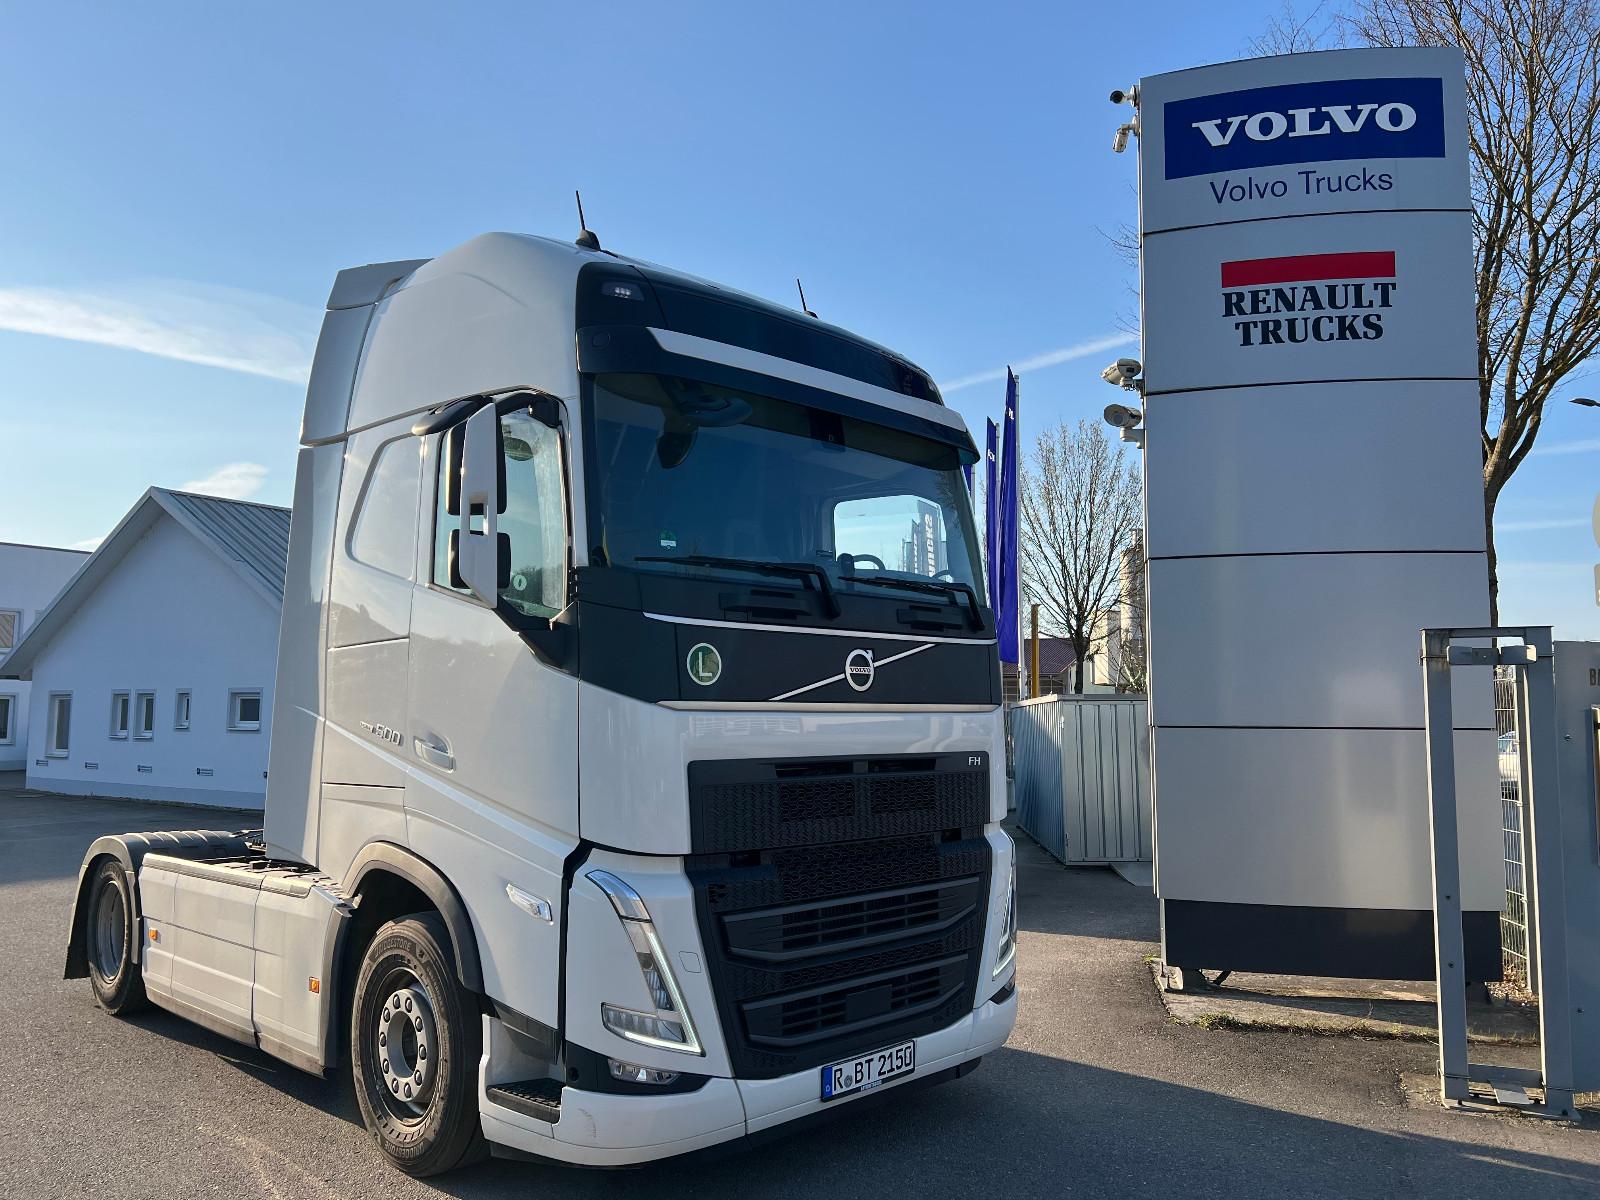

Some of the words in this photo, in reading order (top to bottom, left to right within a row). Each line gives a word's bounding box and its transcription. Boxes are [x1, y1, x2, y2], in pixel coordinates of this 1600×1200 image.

[1191, 102, 1417, 147] VOLVO
[1210, 176, 1288, 204] Volvo
[1297, 167, 1393, 195] Trucks
[1222, 282, 1397, 317] RENAULT
[1235, 313, 1384, 347] TRUCKS
[698, 651, 713, 677] L
[1589, 668, 1600, 686] B
[376, 723, 401, 745] 500
[968, 756, 981, 766] FH
[833, 1067, 844, 1092] R
[854, 1058, 874, 1084] BT
[878, 1046, 912, 1077] 2150
